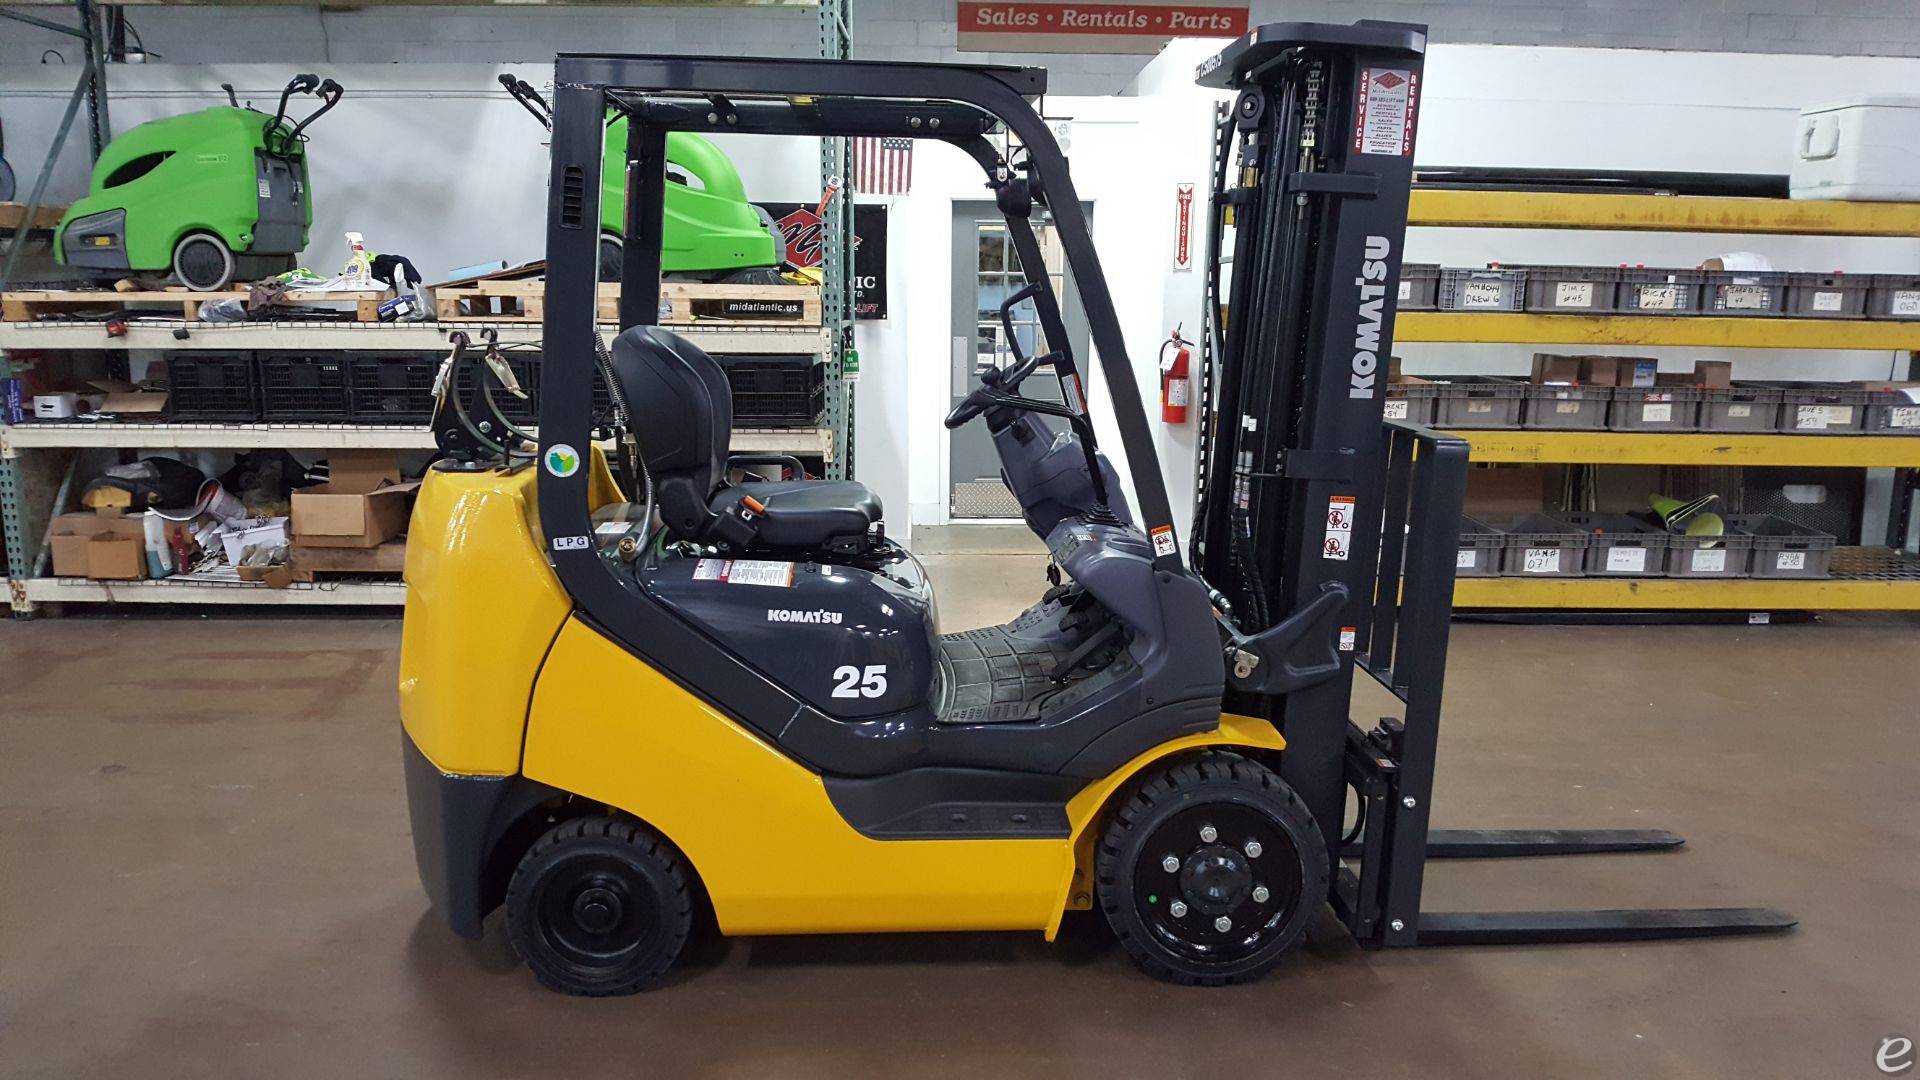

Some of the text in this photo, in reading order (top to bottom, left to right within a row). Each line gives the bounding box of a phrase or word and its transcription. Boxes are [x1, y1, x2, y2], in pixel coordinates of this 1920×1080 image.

[976, 7, 1232, 30] Sales Rentals Parts
[1355, 71, 1368, 148] SERVICE
[1403, 74, 1417, 152] RENTALS
[729, 303, 799, 312] midatlantic.us
[1465, 294, 1490, 305] DREW
[1349, 235, 1390, 399] KOMATSU
[767, 608, 843, 624] KOMATSU
[831, 664, 888, 698] 25
